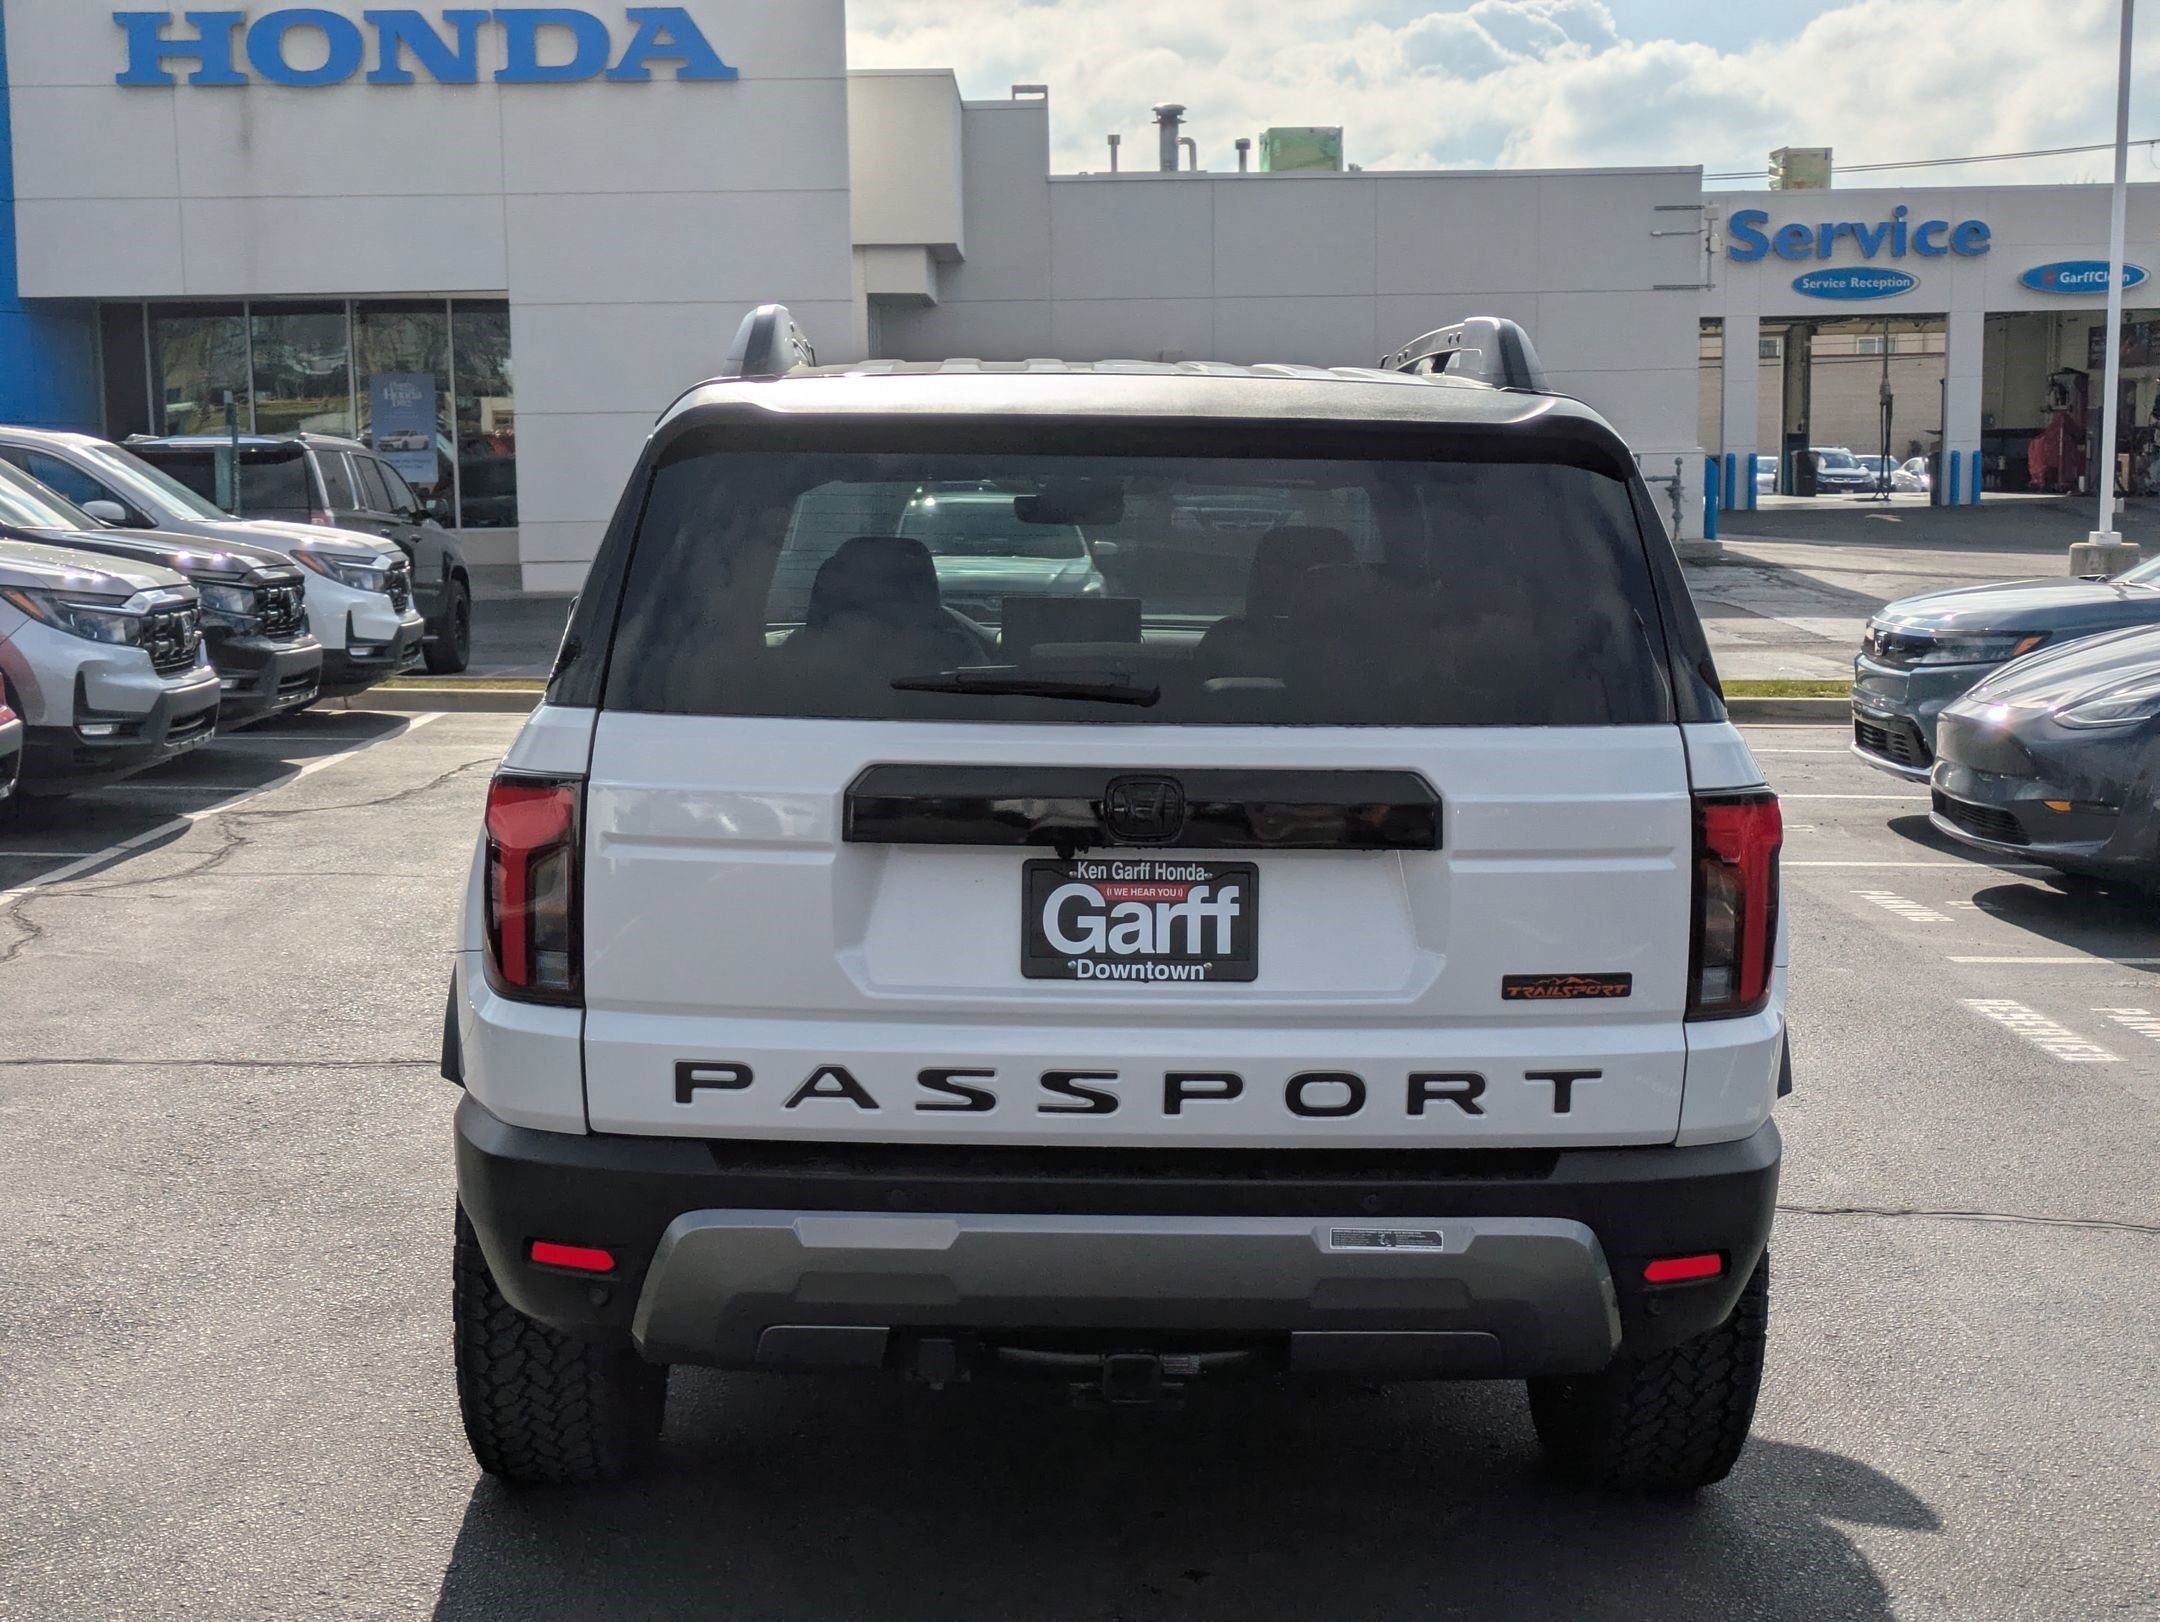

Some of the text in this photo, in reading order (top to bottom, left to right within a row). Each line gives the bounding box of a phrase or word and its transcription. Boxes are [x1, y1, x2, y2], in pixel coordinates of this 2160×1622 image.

[112, 7, 738, 87] HONDA
[1727, 205, 1992, 263] Service
[1802, 276, 1911, 290] Service Reception
[2060, 270, 2130, 283] GarffCln
[1077, 861, 1206, 881] Ken Garff Honda
[1113, 887, 1177, 897] WE HEAR YOU
[1042, 883, 1240, 955] Garff
[1076, 959, 1205, 980] Downtown
[1506, 984, 1629, 998] TRAILSPORT
[1963, 998, 2121, 1062] RESERVED
[674, 1061, 1604, 1118] PASSPORT
